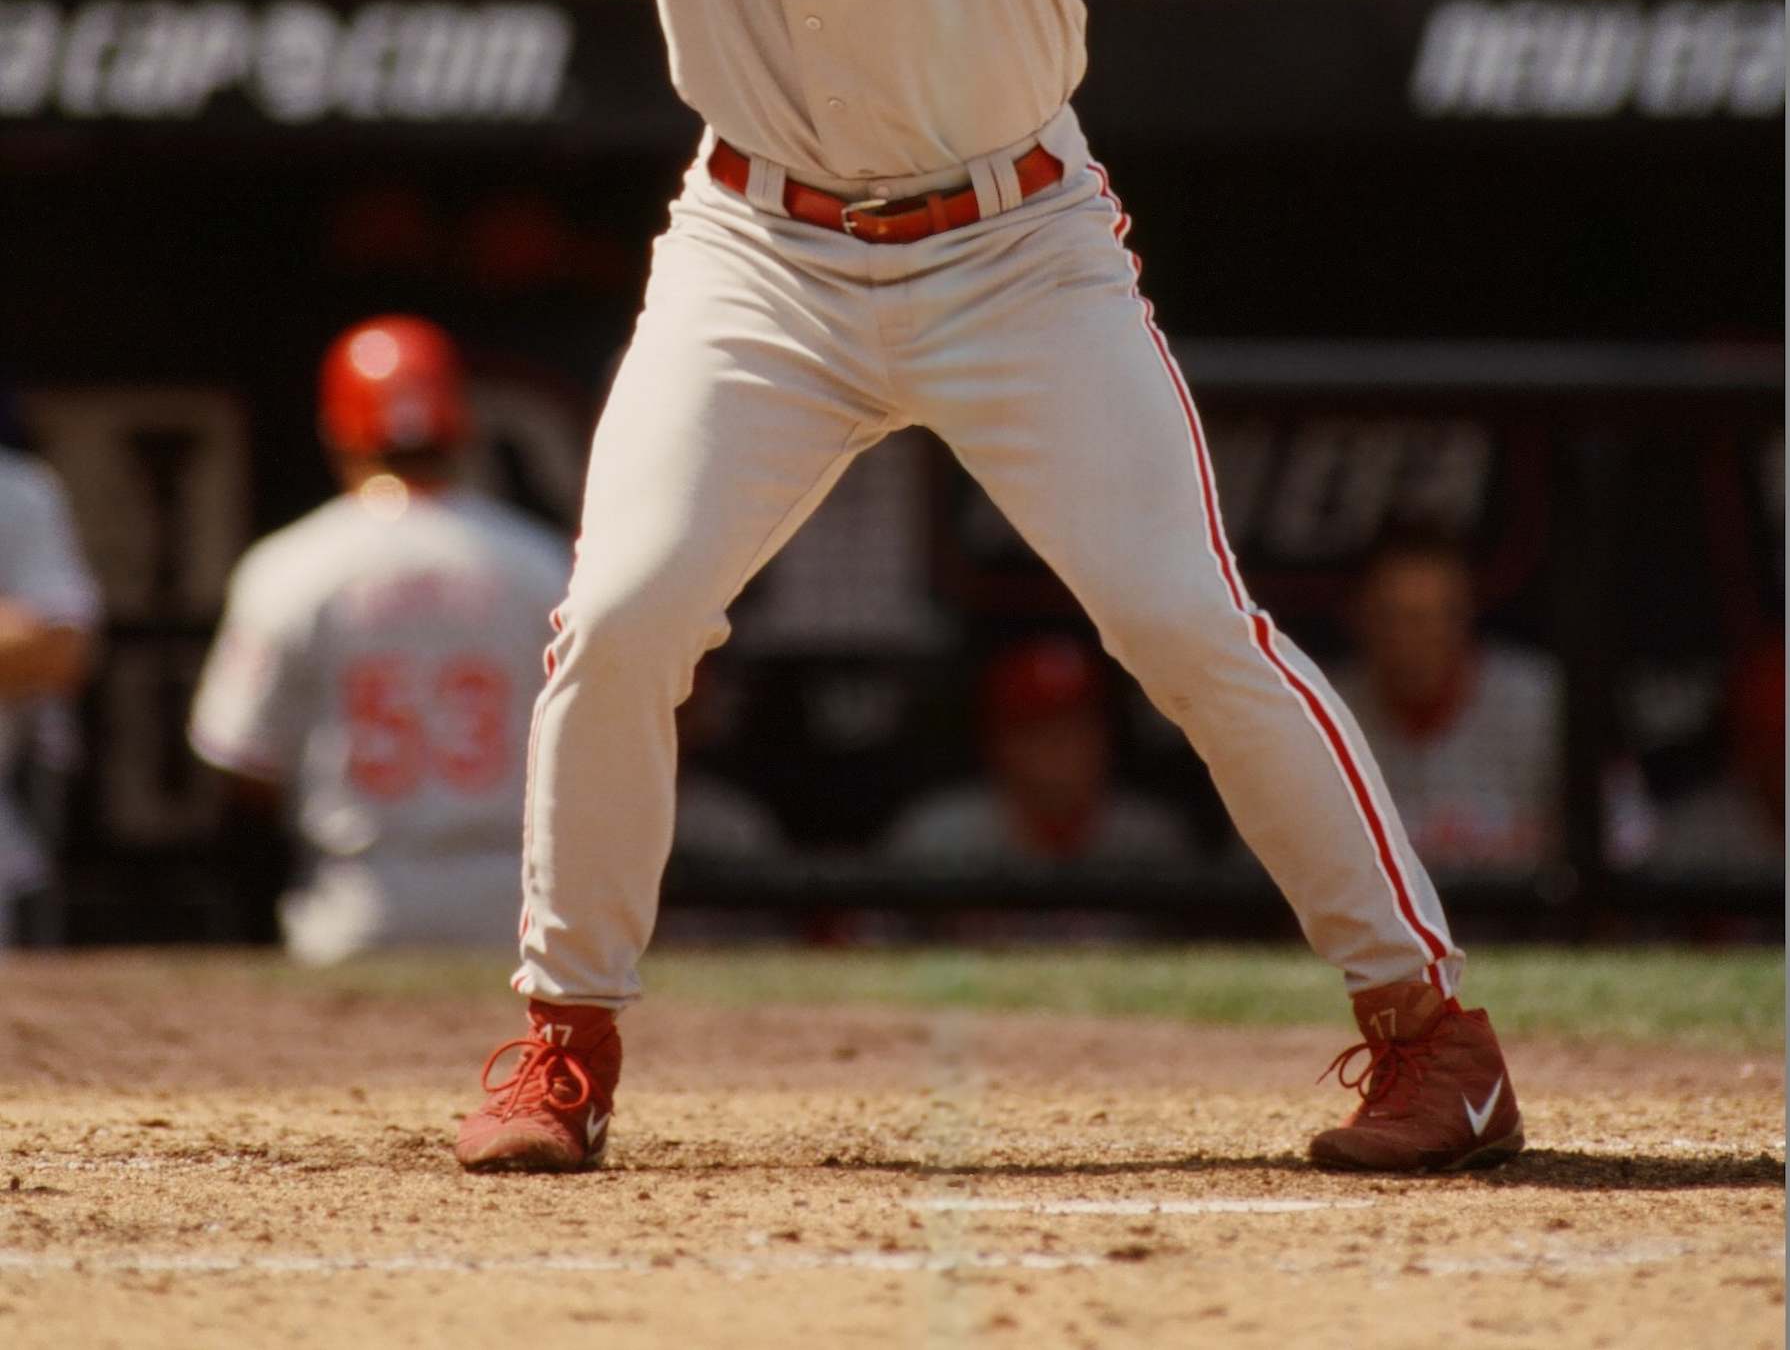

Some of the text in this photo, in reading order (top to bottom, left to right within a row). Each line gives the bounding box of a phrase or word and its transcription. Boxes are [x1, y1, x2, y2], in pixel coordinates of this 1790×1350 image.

[342, 656, 514, 798] 53
[542, 1022, 574, 1047] 17
[1368, 1006, 1398, 1040] 17
